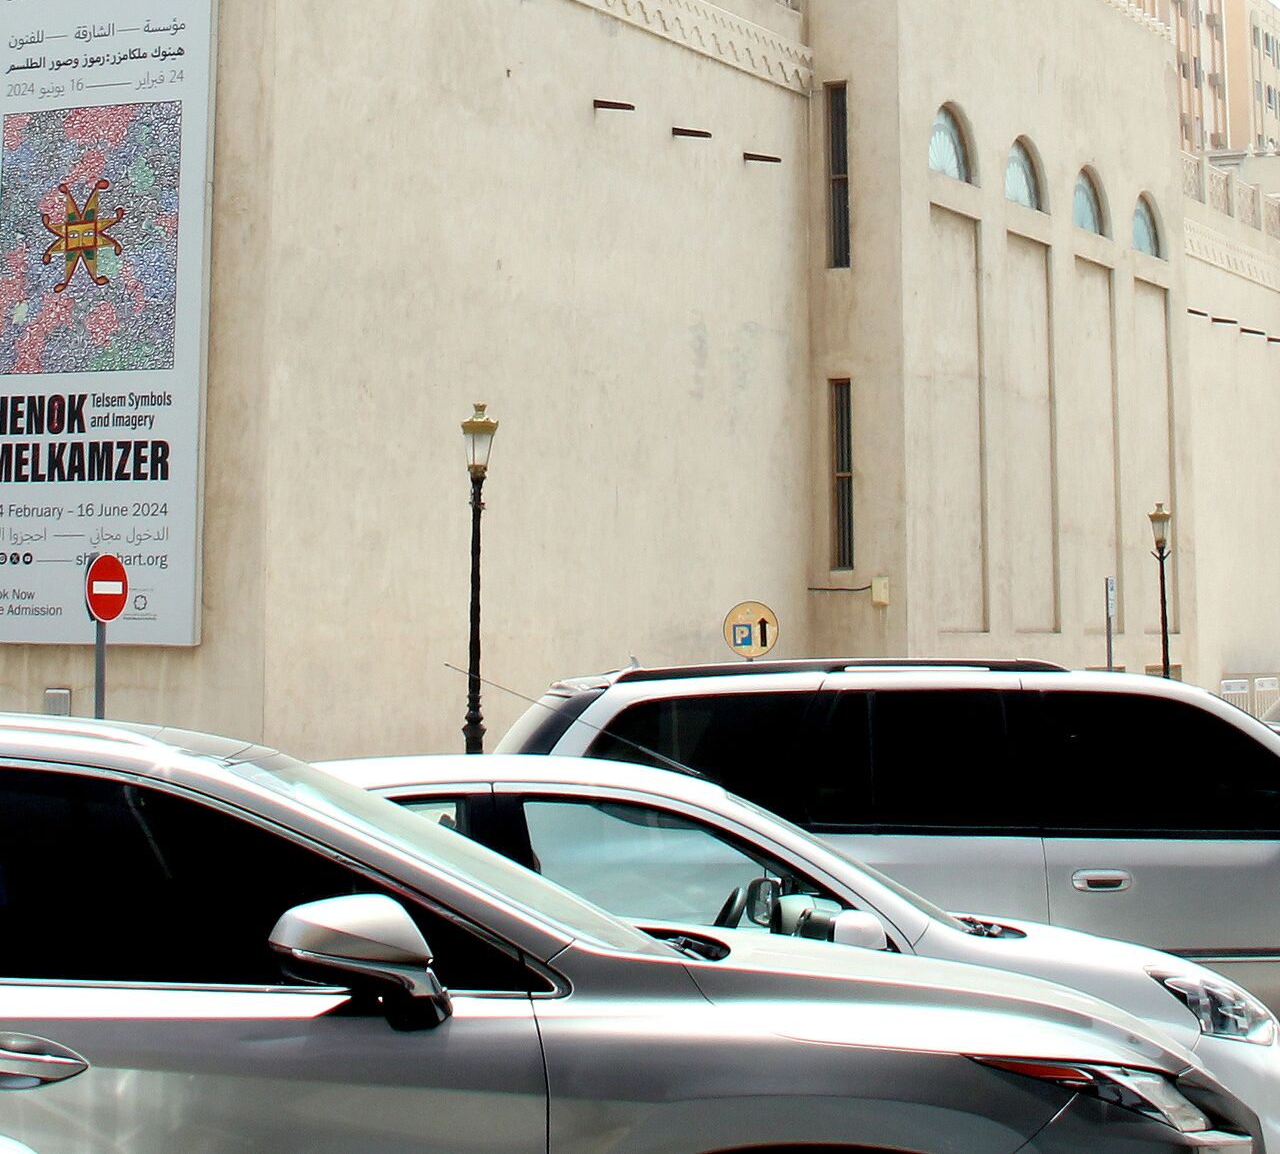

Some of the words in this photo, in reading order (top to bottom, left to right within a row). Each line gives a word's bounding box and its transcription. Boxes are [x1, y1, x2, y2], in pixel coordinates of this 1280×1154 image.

[74, 23, 115, 43] الشارقة
[143, 17, 186, 35] مؤسسة
[8, 30, 45, 49] للفنون
[151, 46, 185, 59] هينوك
[5, 57, 46, 75] الطلسم
[49, 57, 79, 72] وصور
[70, 78, 84, 92] 16
[134, 71, 165, 91] فبراير
[168, 69, 185, 84] 24
[7, 83, 35, 98] 2024
[38, 85, 65, 99] يونيو
[90, 392, 126, 408] Telsem
[128, 391, 172, 410] Symbols
[90, 412, 110, 428] and
[111, 412, 155, 431] Imagery
[8, 503, 64, 520] February
[77, 503, 94, 517] 16
[97, 503, 128, 517] June
[131, 502, 168, 517] 2024
[9, 527, 47, 545] احجزوا
[89, 526, 122, 548] مجاني
[125, 526, 169, 546] الدخول
[12, 588, 36, 600] Now
[6, 604, 63, 616] Admission
[734, 625, 750, 645] P
